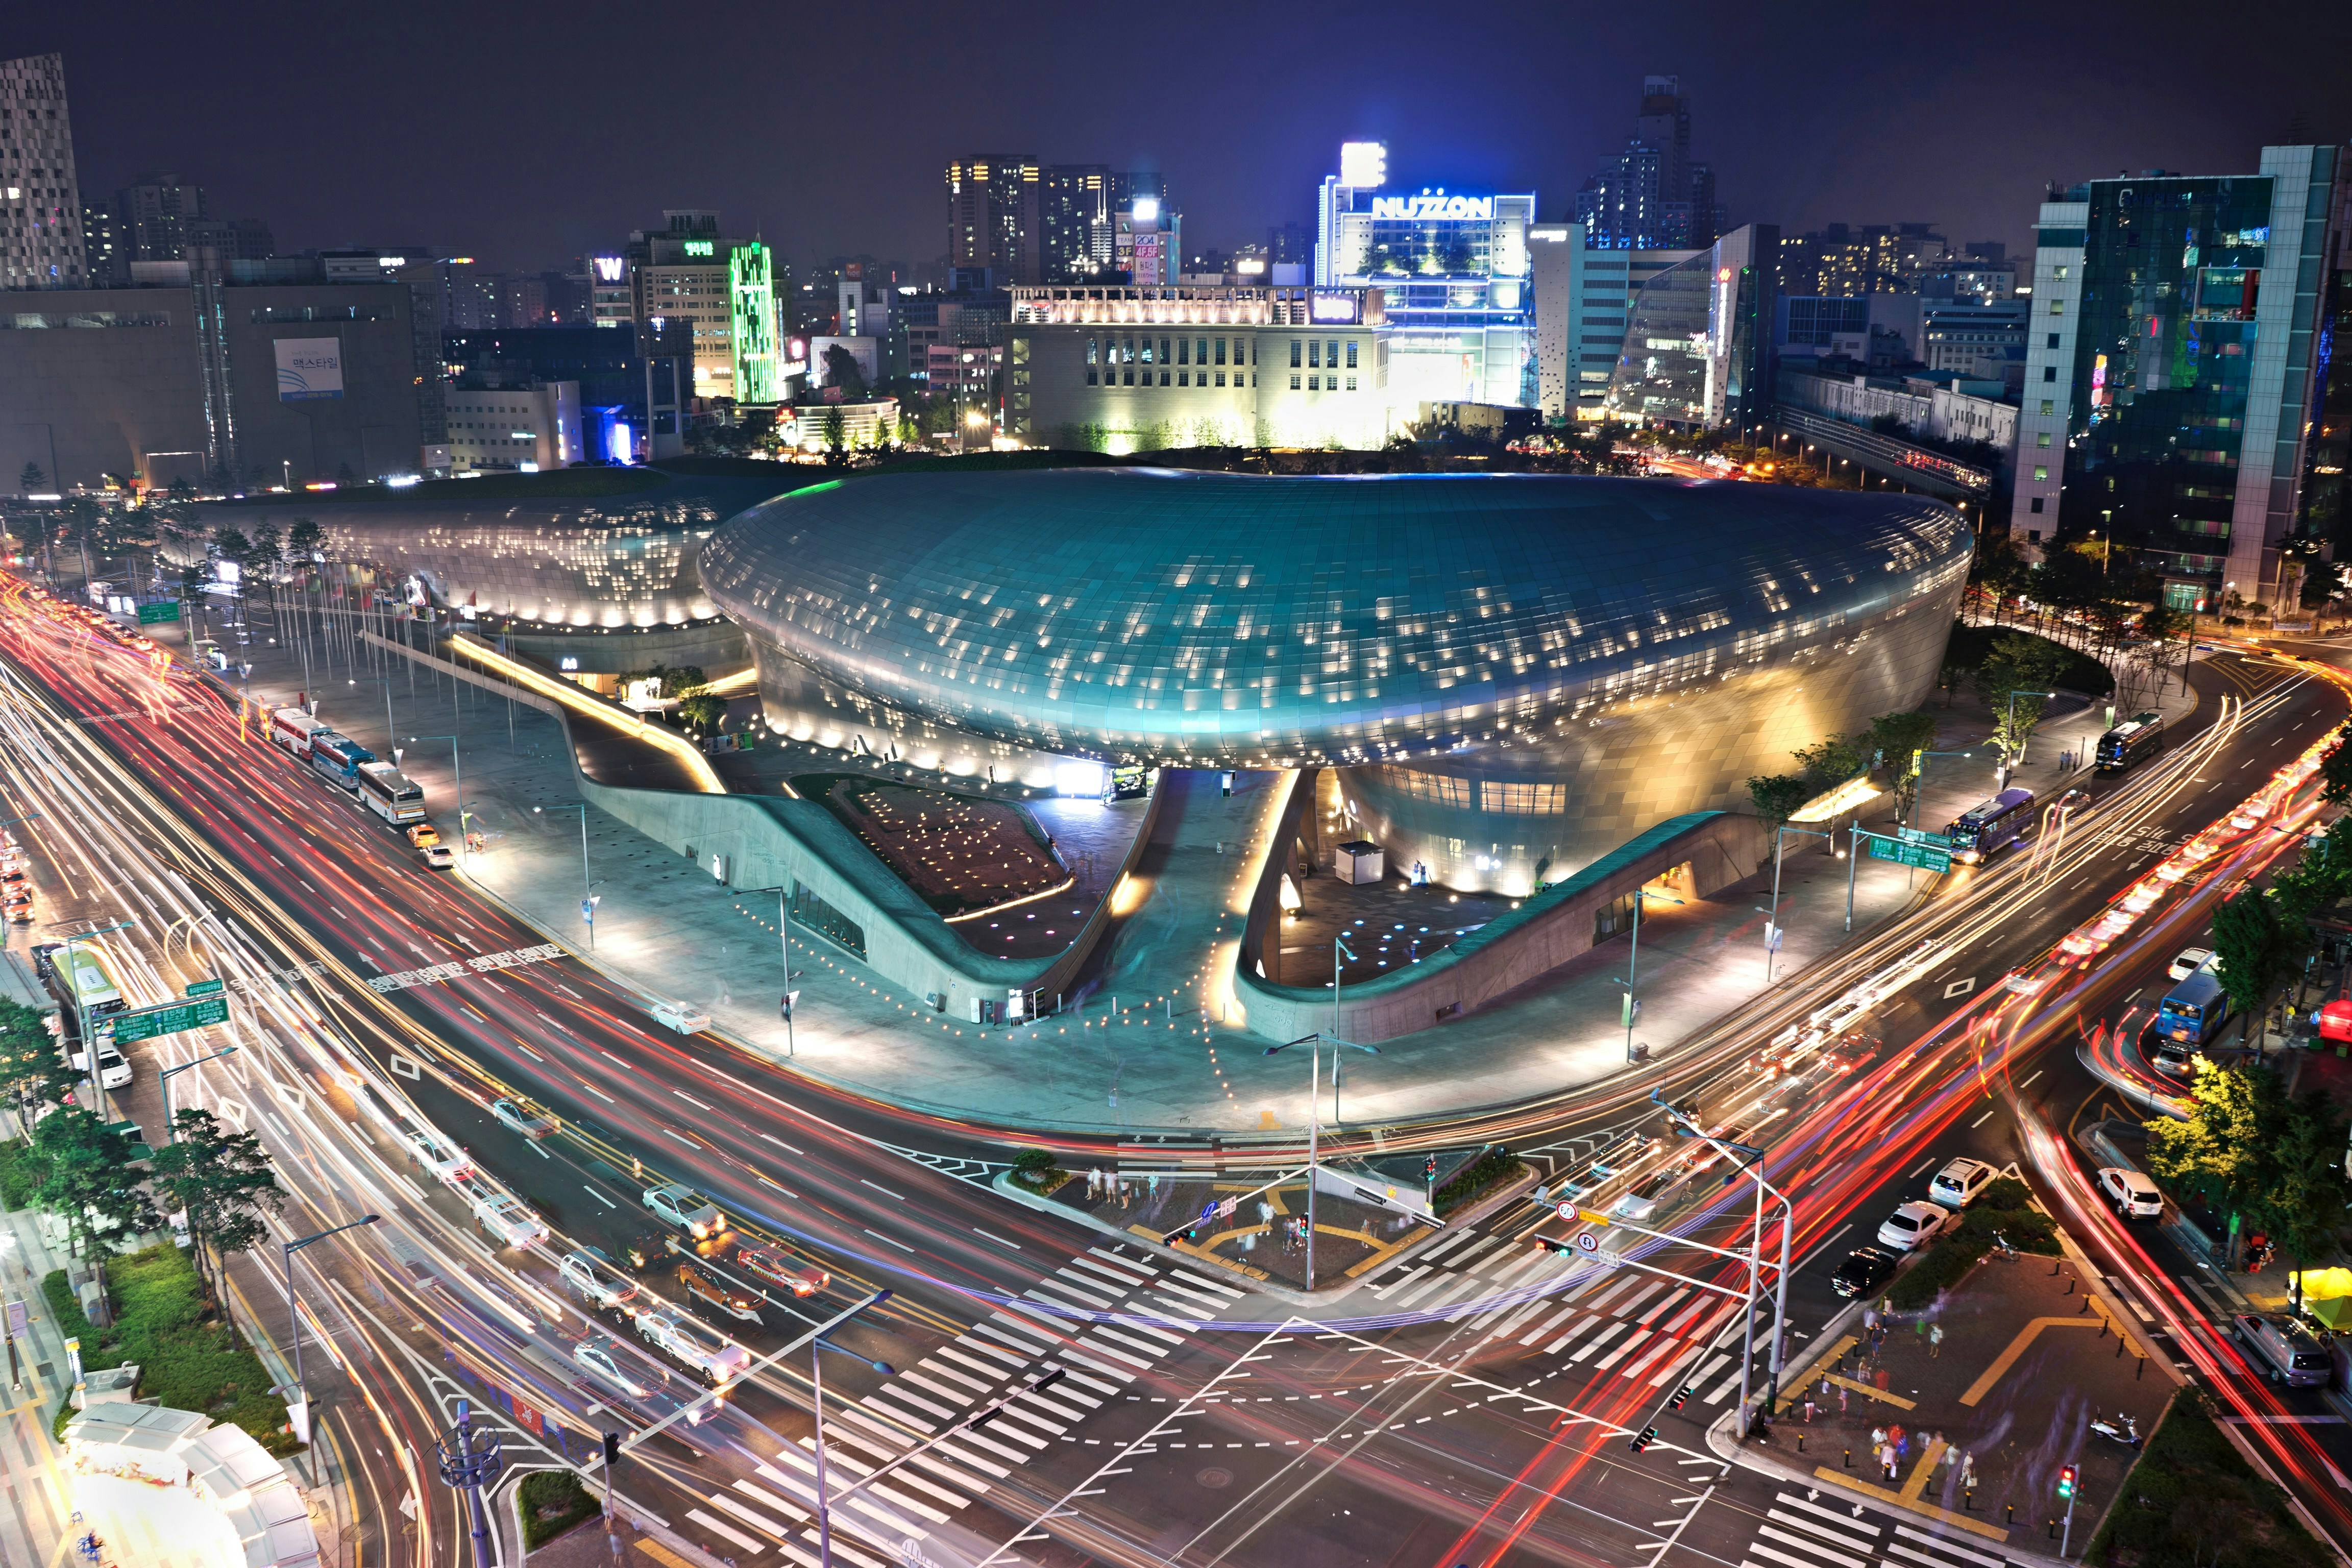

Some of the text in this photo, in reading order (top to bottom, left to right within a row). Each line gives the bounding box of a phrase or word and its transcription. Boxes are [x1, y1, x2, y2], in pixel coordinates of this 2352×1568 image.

[1372, 195, 1492, 219] NUZZON
[1137, 236, 1154, 245] 204
[1118, 247, 1132, 256] 3F
[1140, 261, 1154, 271] 원피스
[293, 357, 338, 370] 맥스타일
[1560, 1206, 1573, 1216] 60
